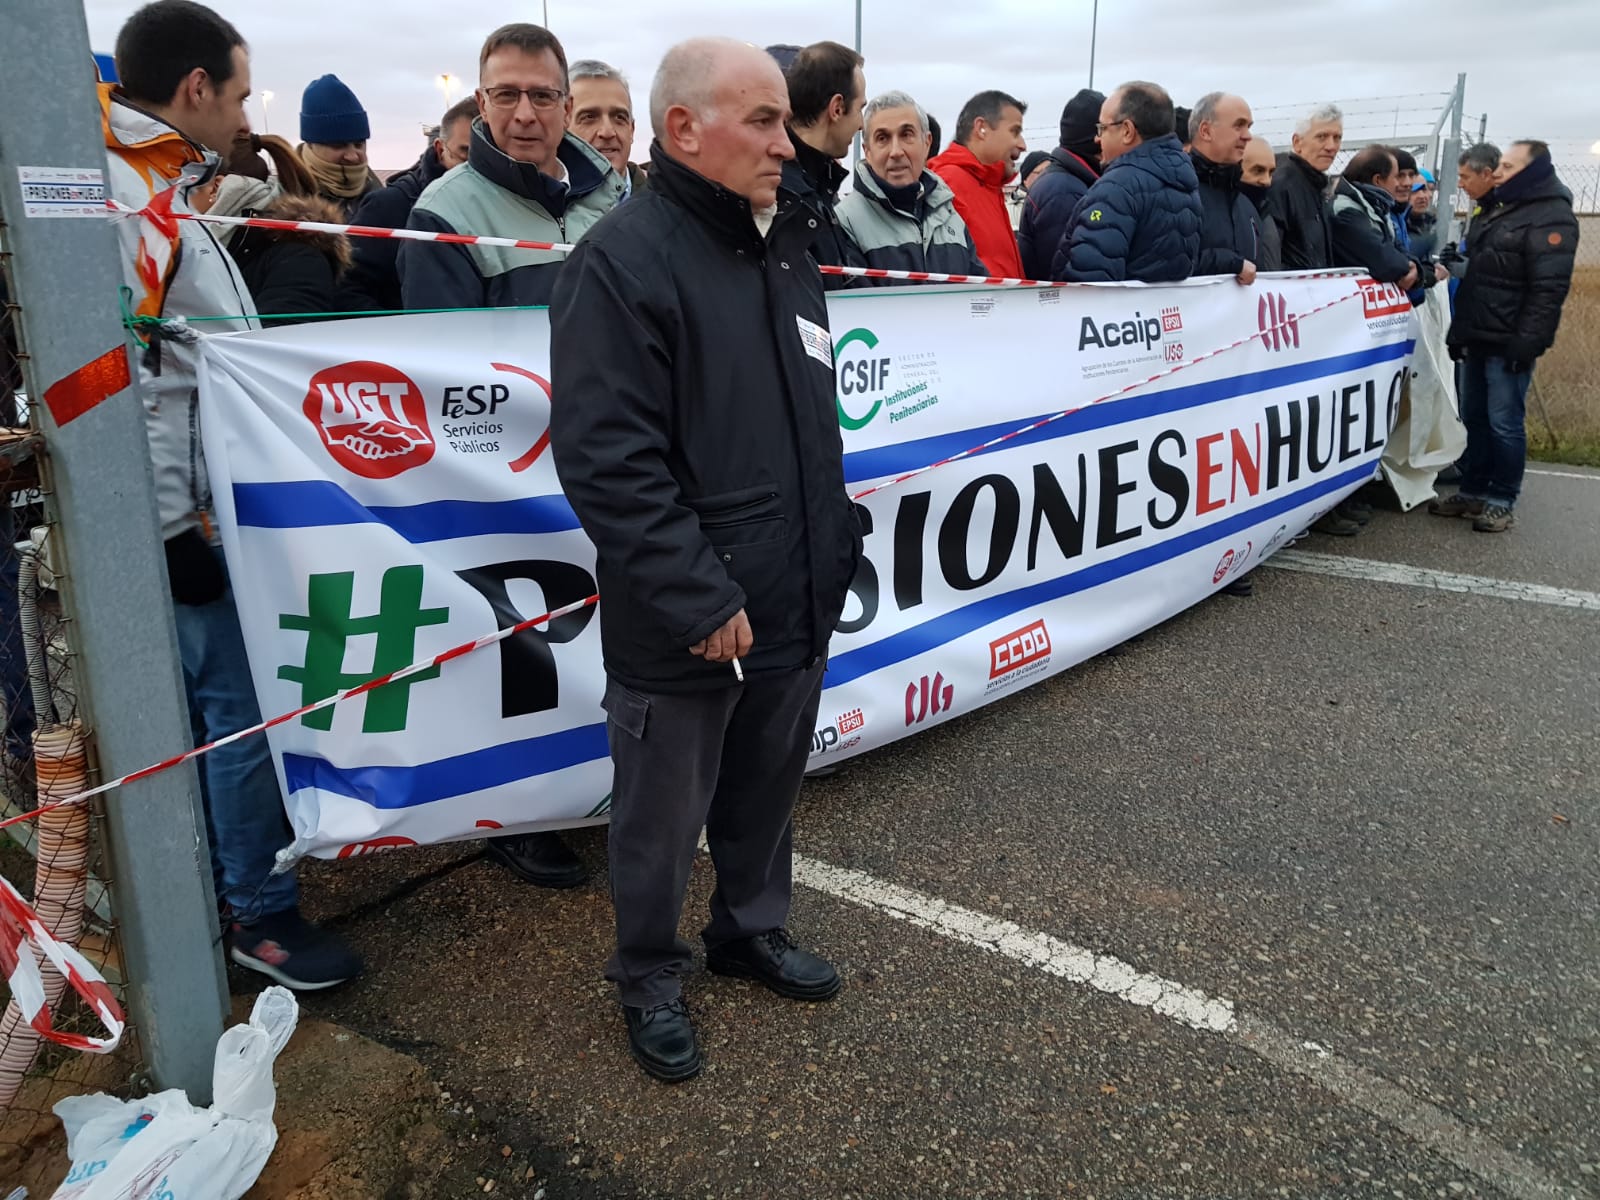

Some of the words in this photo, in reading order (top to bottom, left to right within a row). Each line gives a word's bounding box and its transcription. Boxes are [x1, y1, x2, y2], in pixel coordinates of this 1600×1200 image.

[1078, 311, 1161, 351] Acaip
[841, 358, 890, 395] CSIF
[316, 382, 412, 428] UGT
[884, 381, 928, 407] Instituciones
[889, 394, 939, 424] Penitenciarias
[442, 421, 503, 438] Servicios
[449, 440, 500, 455] Públicos
[995, 625, 1048, 668] CCOO
[842, 715, 862, 732] EPSU
